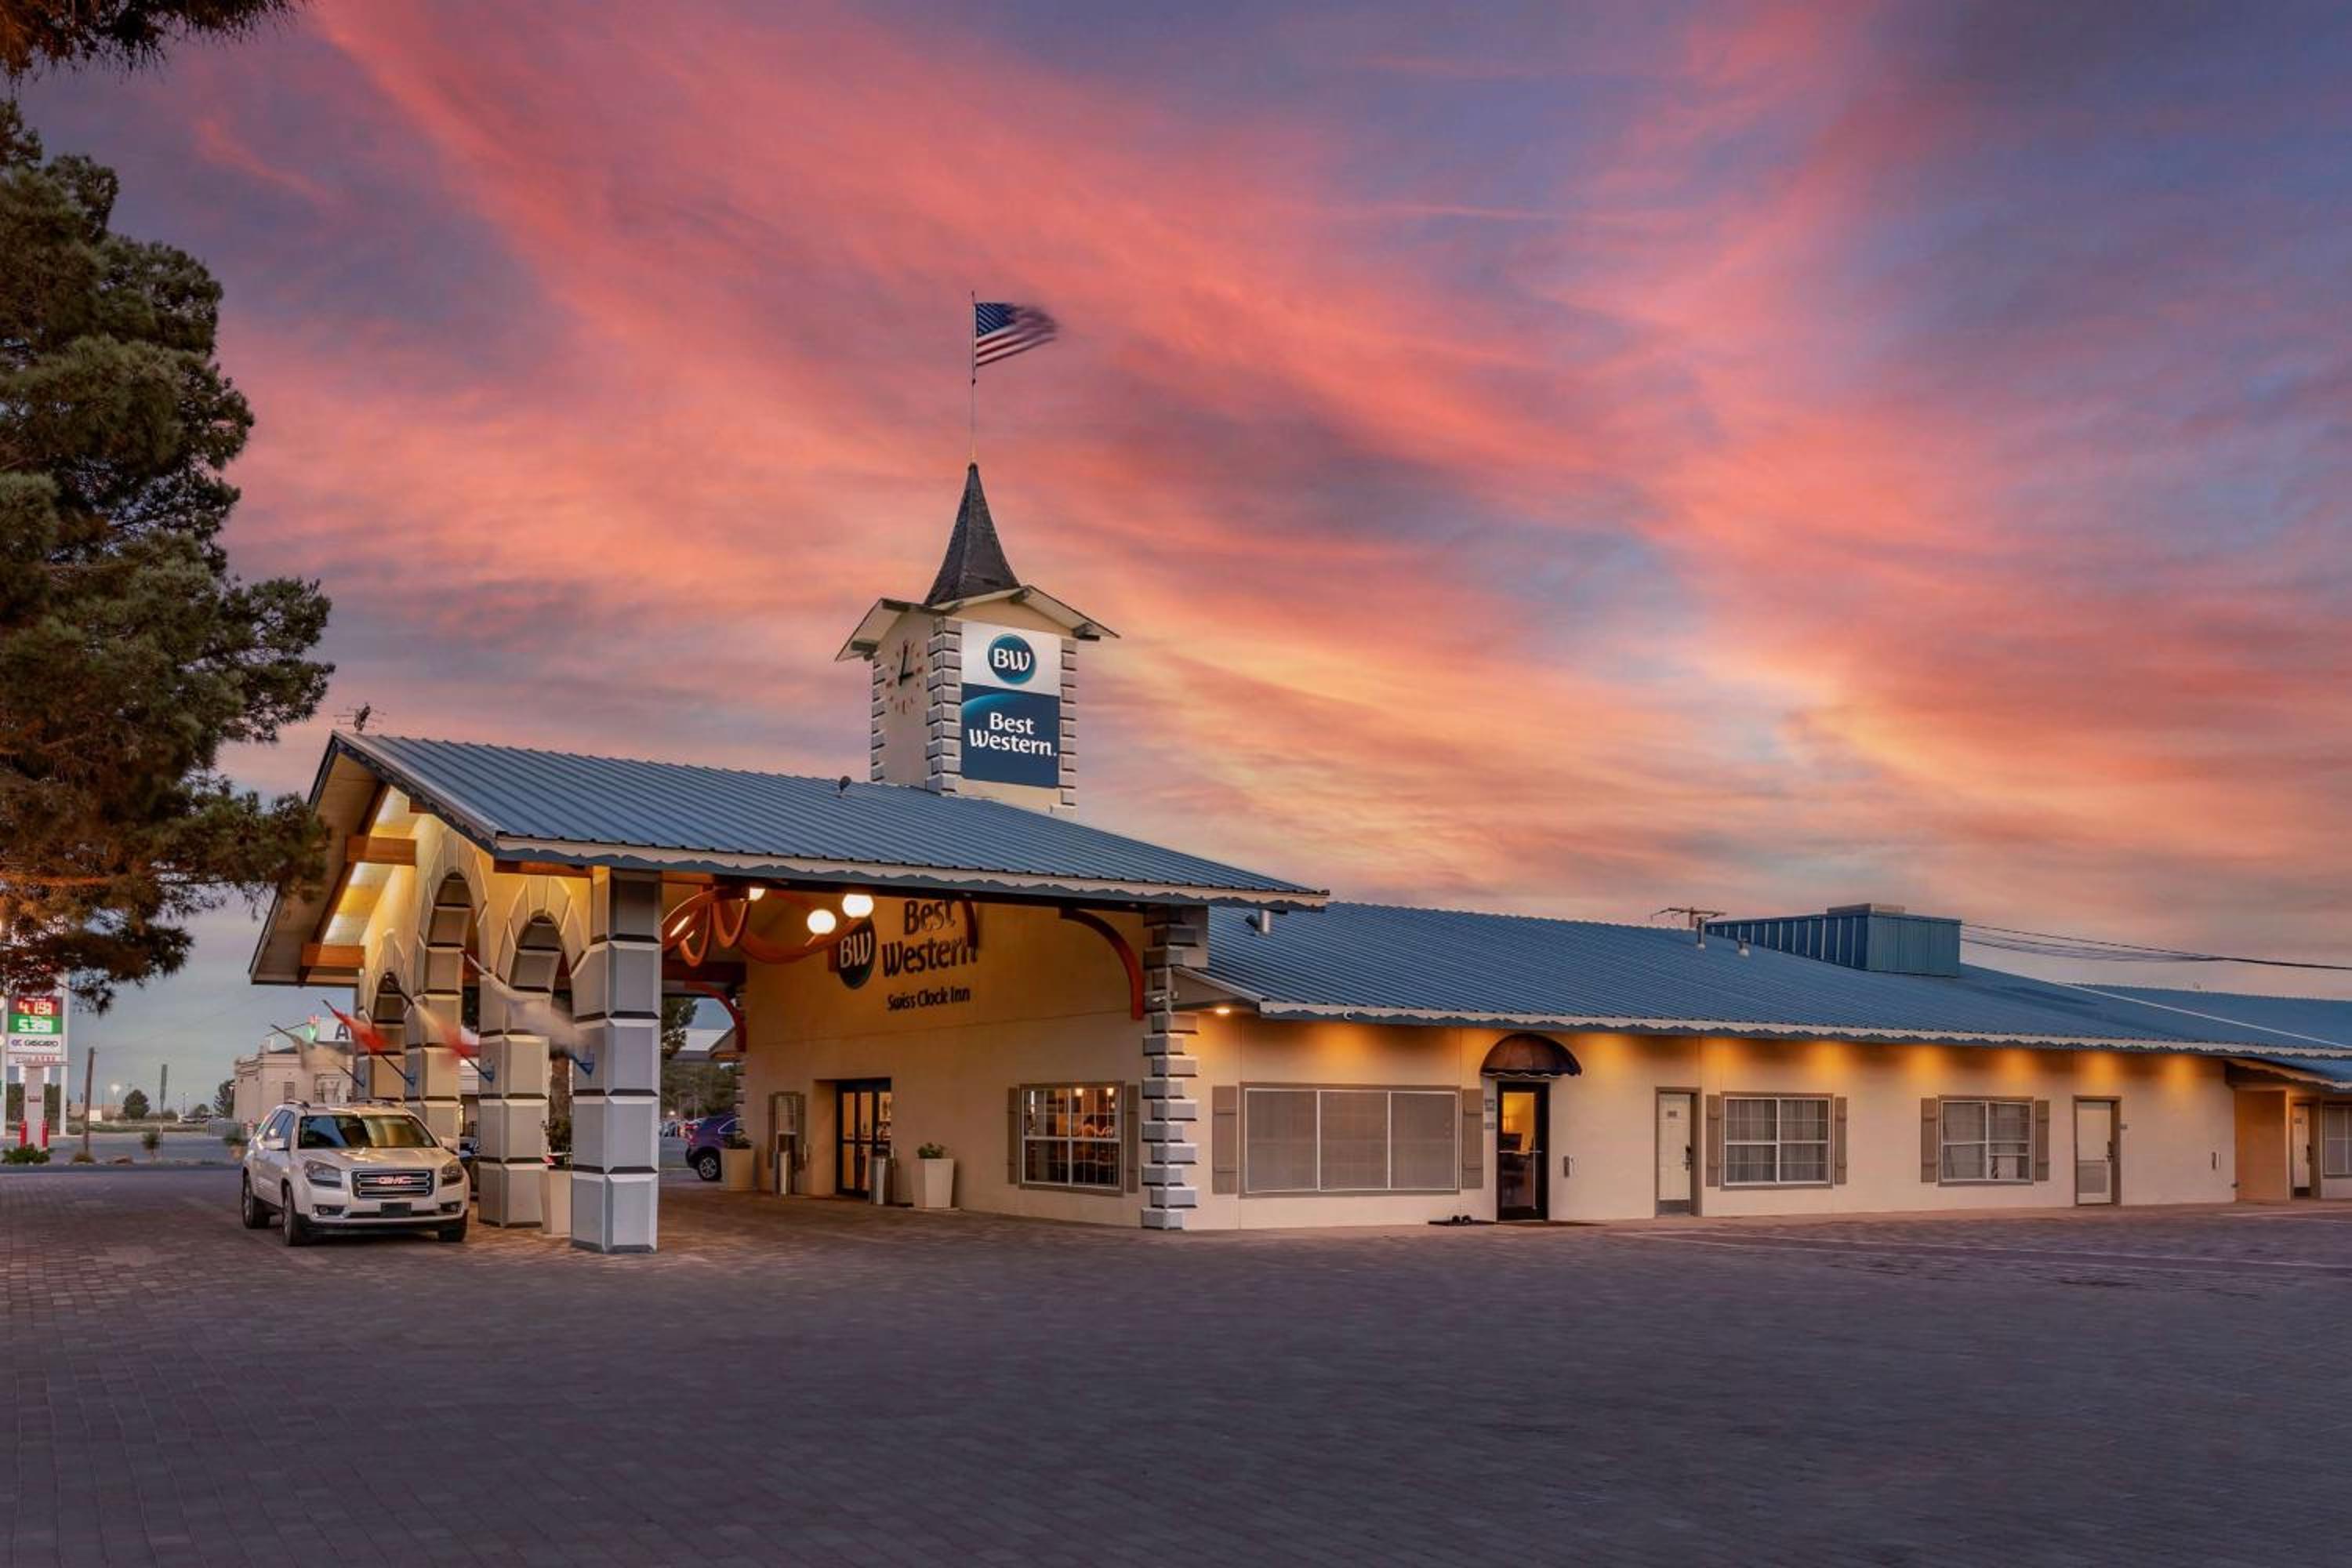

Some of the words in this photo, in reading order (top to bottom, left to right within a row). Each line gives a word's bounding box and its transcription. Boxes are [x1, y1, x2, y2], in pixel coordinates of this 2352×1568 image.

[993, 648, 1031, 672] BW
[989, 712, 1035, 735] Best
[903, 899, 956, 935] Best
[839, 931, 873, 969] BW
[882, 936, 978, 978] Western
[887, 993, 916, 1011] Swiss
[917, 987, 949, 1007] Clock
[950, 985, 971, 1004] Inn
[378, 1176, 412, 1185] GMC
